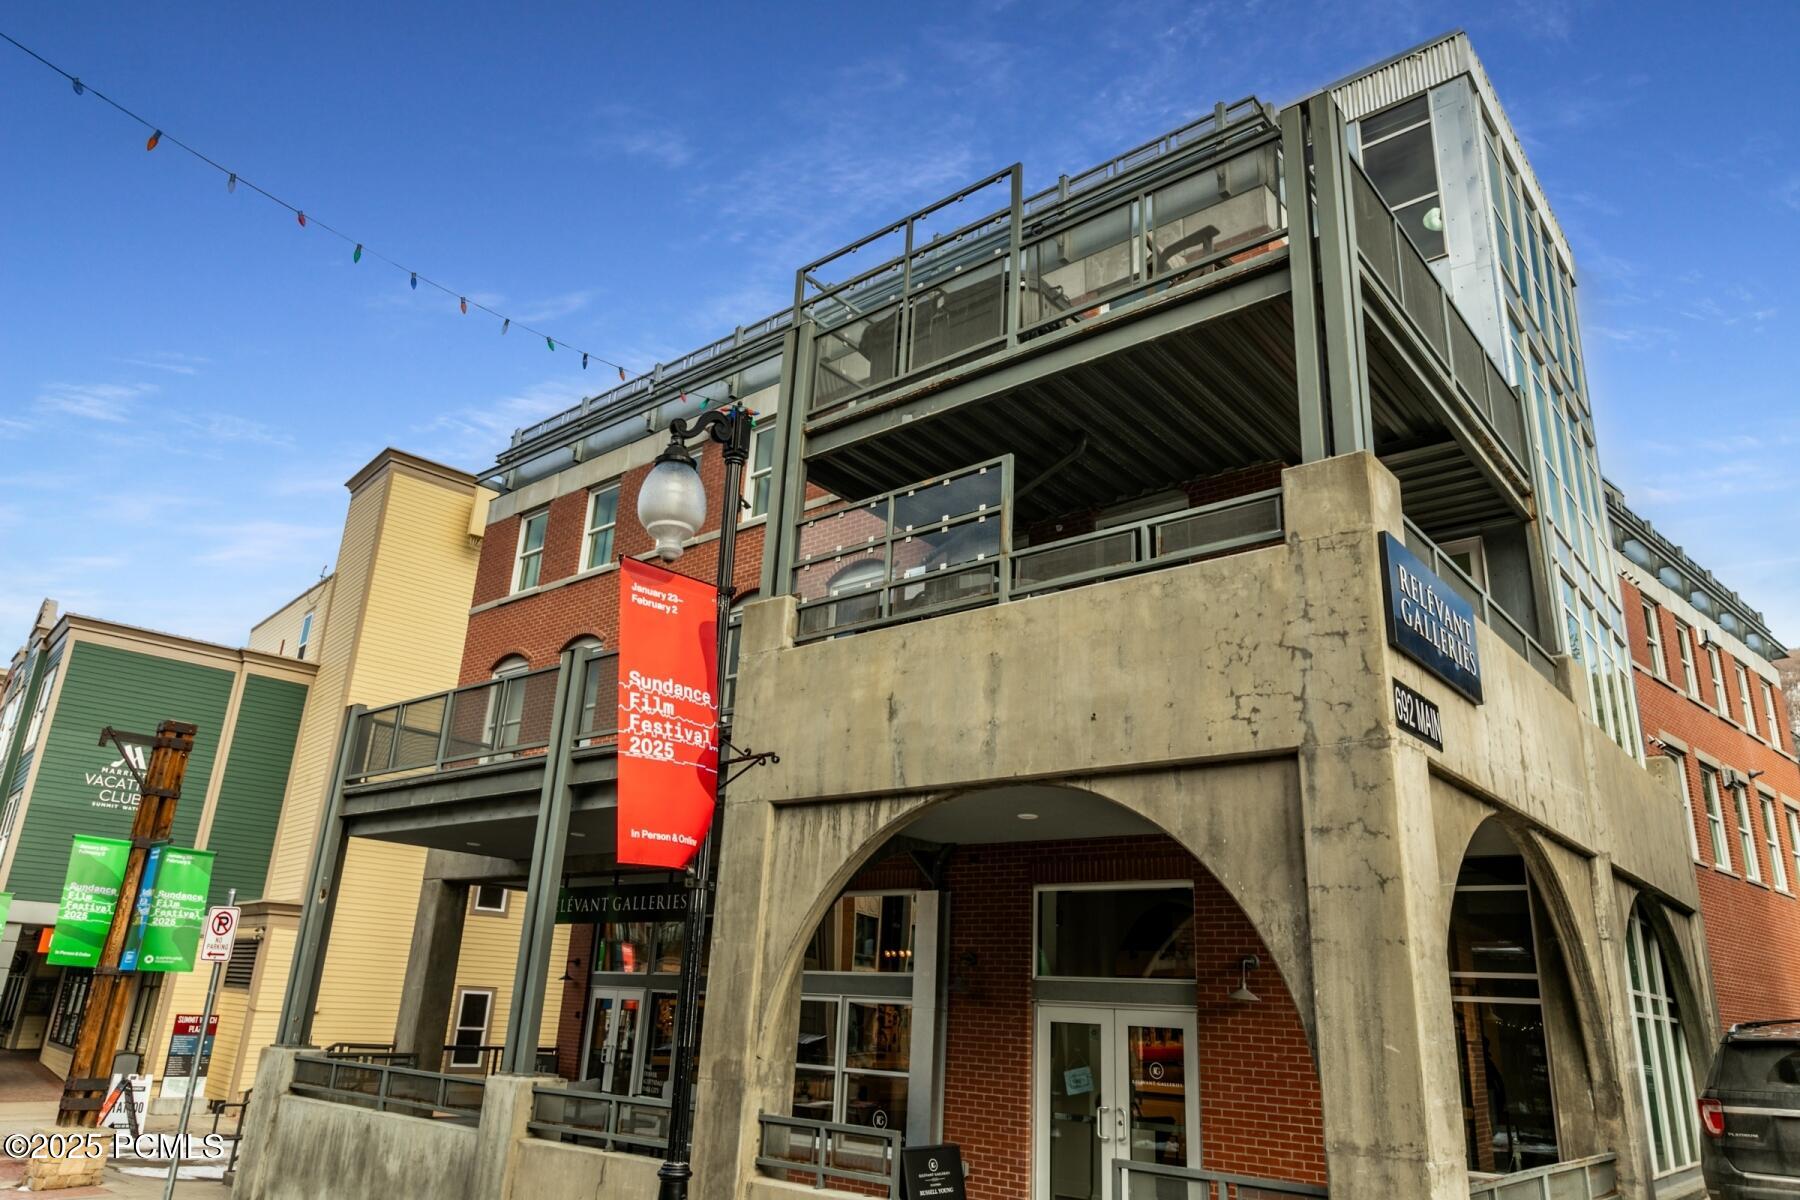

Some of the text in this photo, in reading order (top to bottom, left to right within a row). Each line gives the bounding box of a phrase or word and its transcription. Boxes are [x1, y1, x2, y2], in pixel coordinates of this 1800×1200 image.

[631, 582, 667, 601] January
[631, 593, 678, 614] February 2
[1398, 563, 1472, 646] RELÉVANT
[1400, 598, 1477, 676] GALLERIES
[629, 670, 711, 705] Sundance
[629, 691, 675, 716] Film
[1395, 686, 1442, 743] 692 MAIN
[629, 713, 711, 746] Festival
[629, 735, 675, 759] 2025
[85, 772, 140, 791] VACATI
[101, 767, 147, 778] MARRIT
[641, 829, 671, 841] Person
[69, 882, 118, 896] Sundance
[158, 889, 203, 902] Sundance
[556, 894, 687, 912] LÉVANT GALLERIES
[207, 943, 229, 951] PARKING
[177, 1015, 199, 1024] SUMMIT
